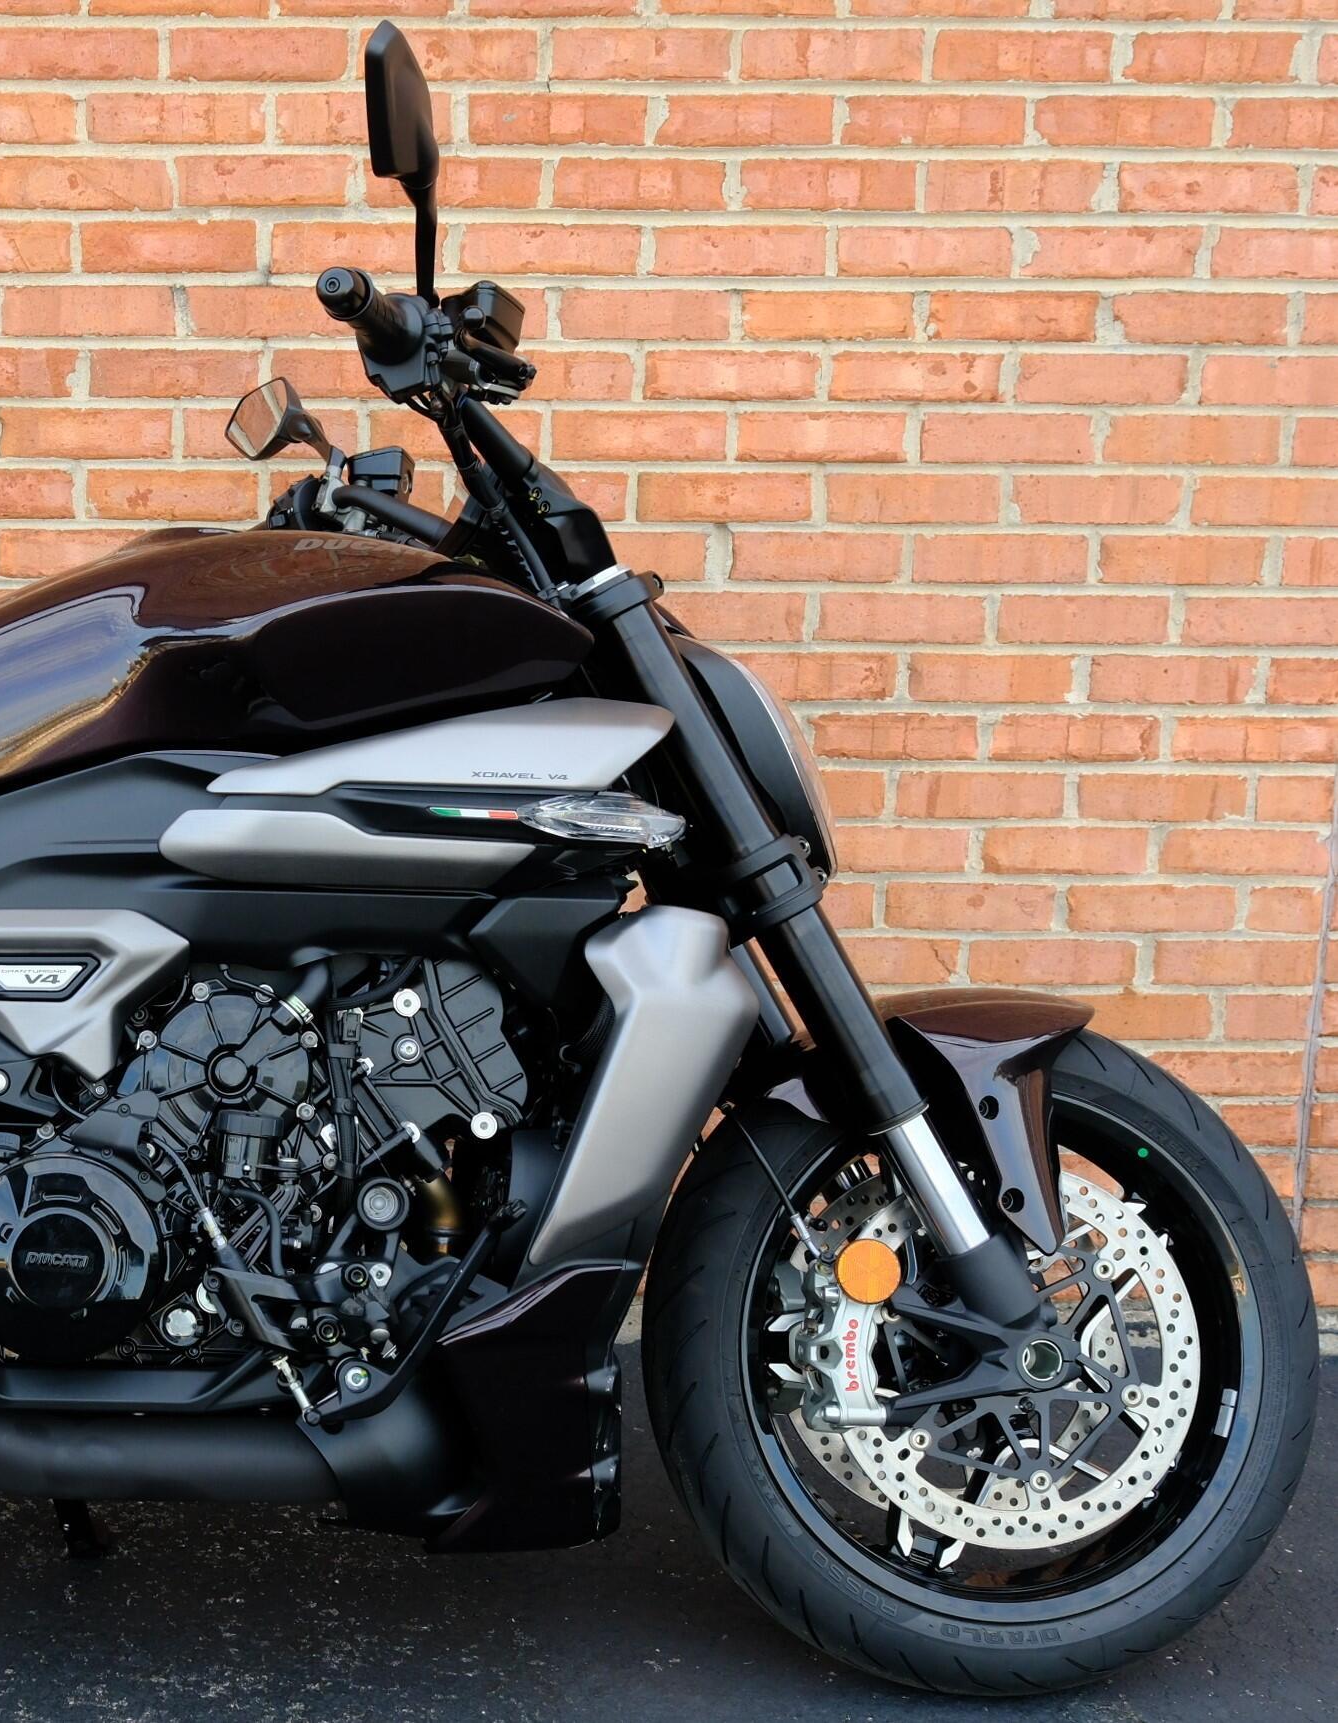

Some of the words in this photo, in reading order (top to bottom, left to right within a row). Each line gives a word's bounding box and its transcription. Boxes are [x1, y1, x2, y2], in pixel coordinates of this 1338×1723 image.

[471, 771, 542, 780] XDIAVEL
[548, 773, 568, 781] V4
[24, 974, 60, 984] V4
[24, 1251, 89, 1268] DUCATI
[842, 1318, 860, 1392] brembo
[812, 1549, 898, 1618] ROSSO
[940, 1622, 1062, 1645] DIABLO
